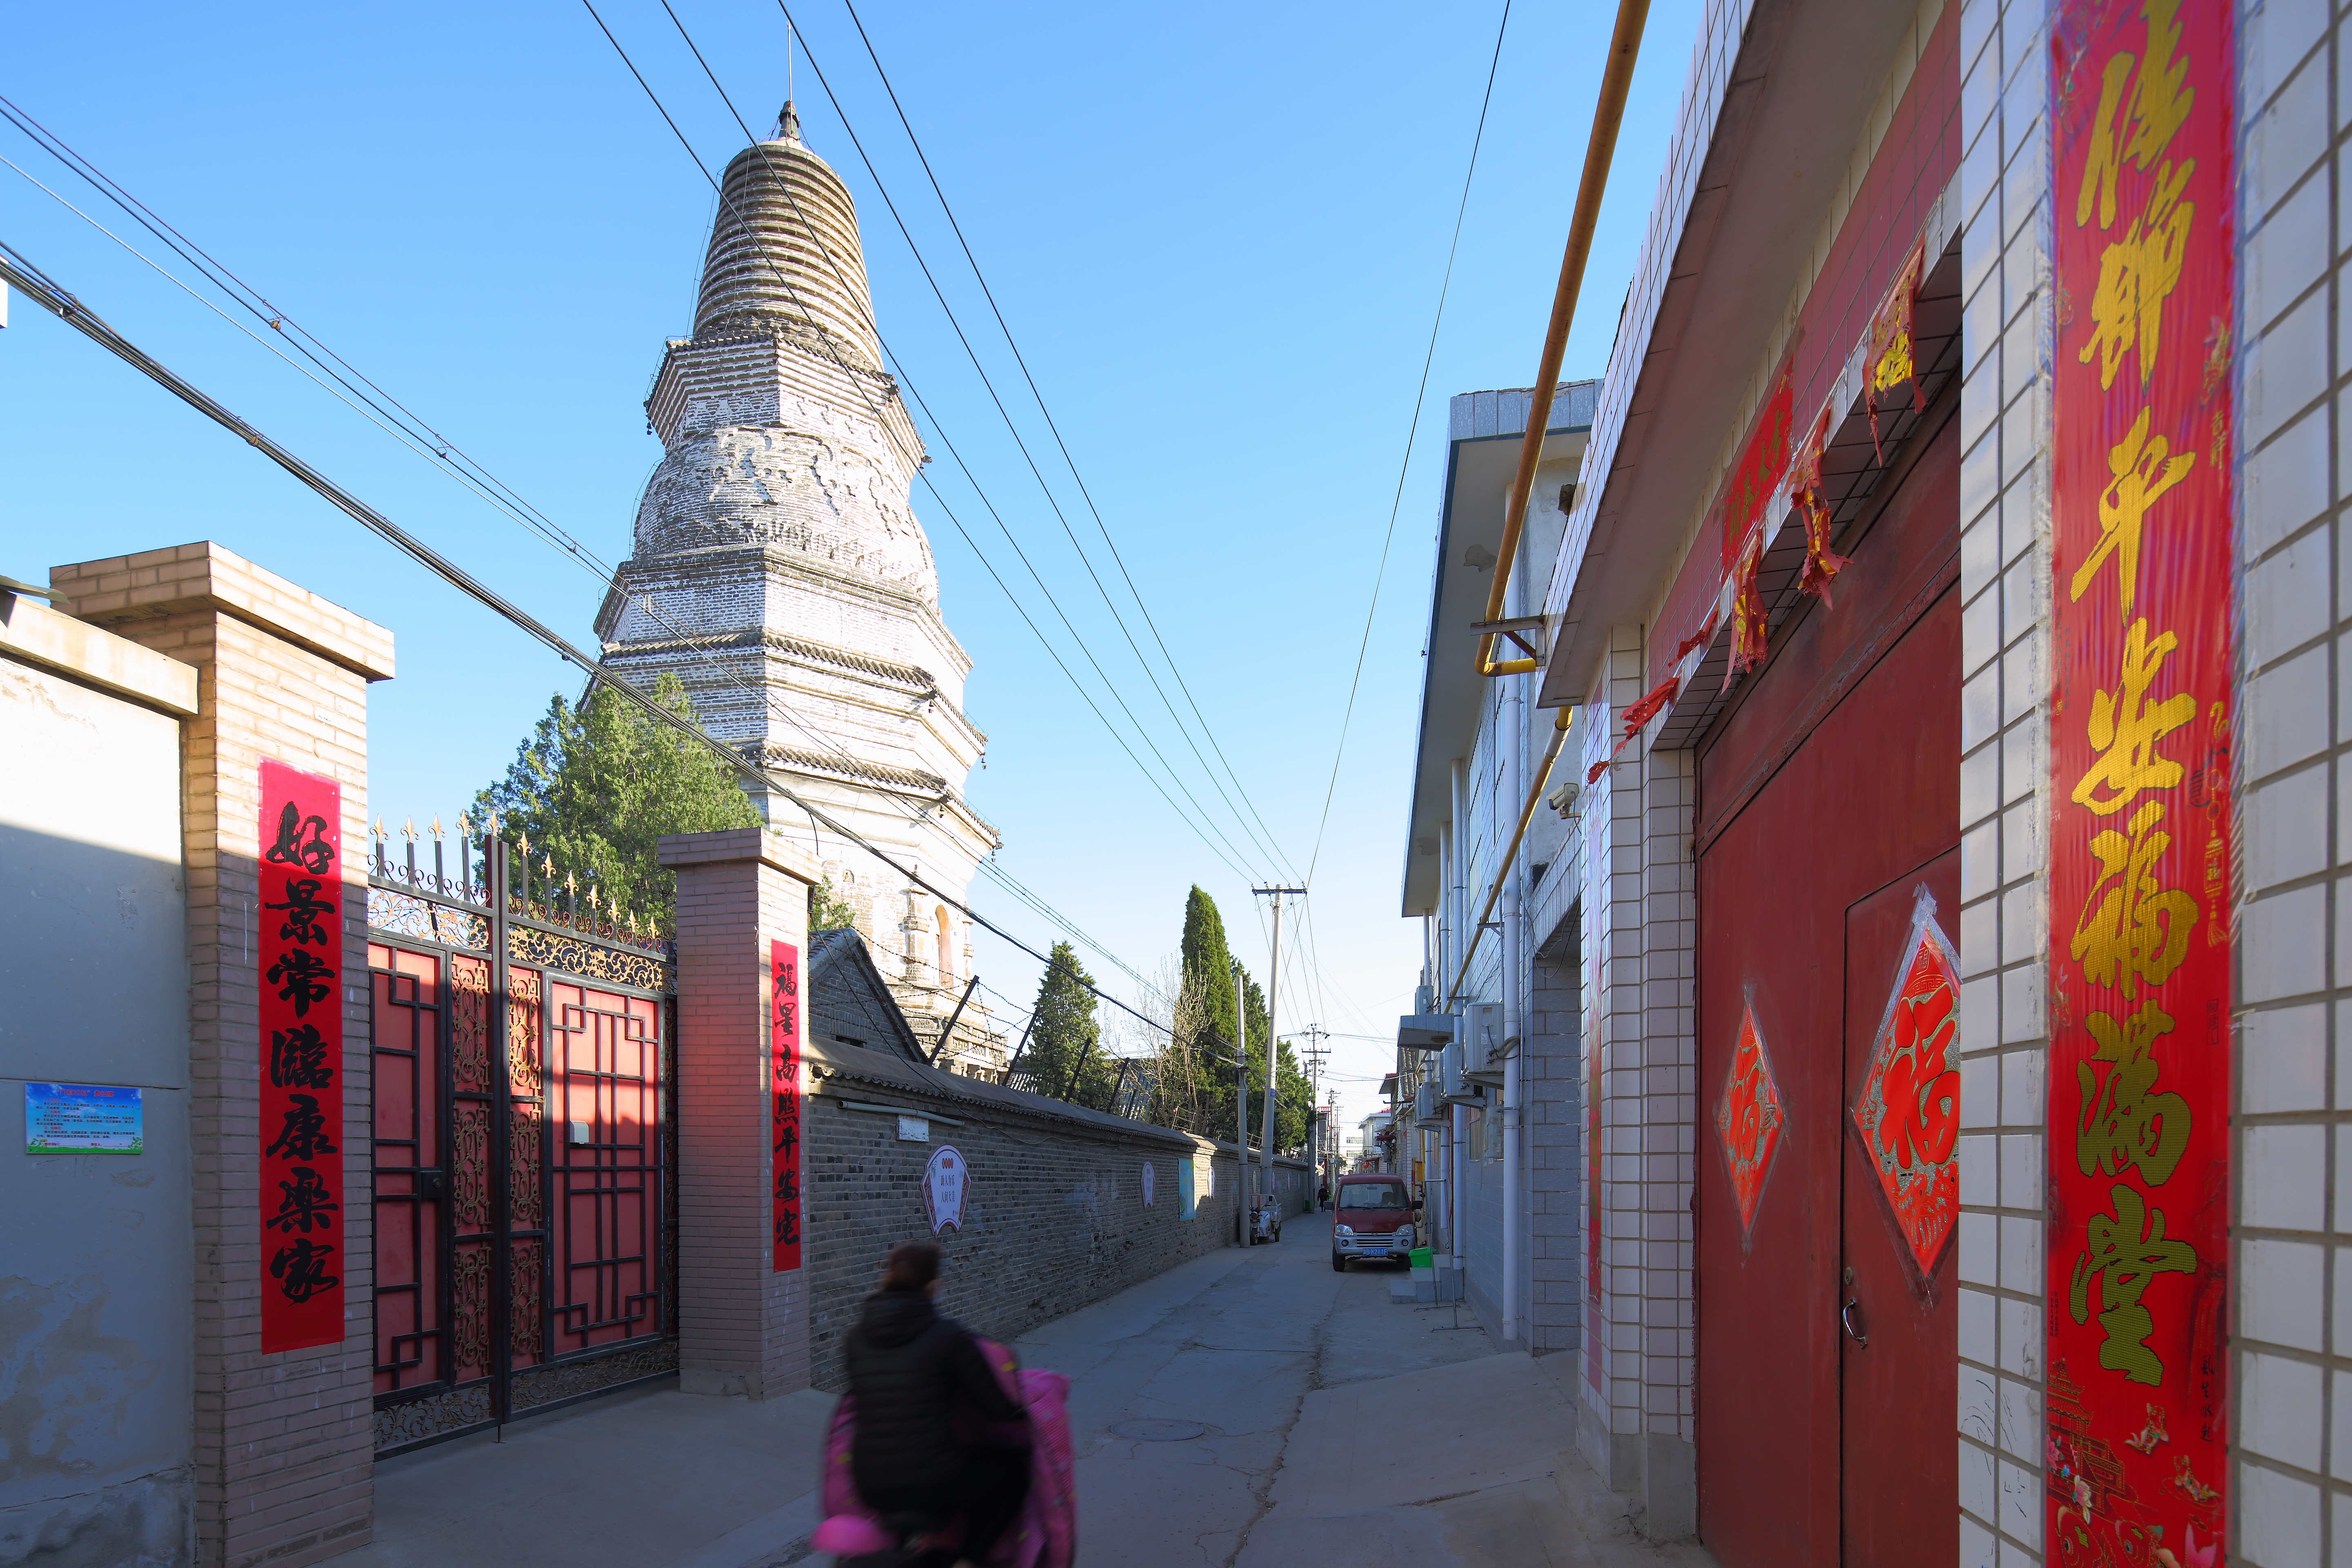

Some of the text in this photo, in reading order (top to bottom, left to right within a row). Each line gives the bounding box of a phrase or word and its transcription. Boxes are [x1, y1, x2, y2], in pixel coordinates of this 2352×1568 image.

[1880, 982, 1960, 1170] 福
[1728, 1043, 1760, 1161] 福
[1763, 1102, 1778, 1131] 家
[1859, 1090, 1878, 1130] 全
[941, 1174, 955, 1186] 助人为乐
[941, 1190, 955, 1203] 人间大美
